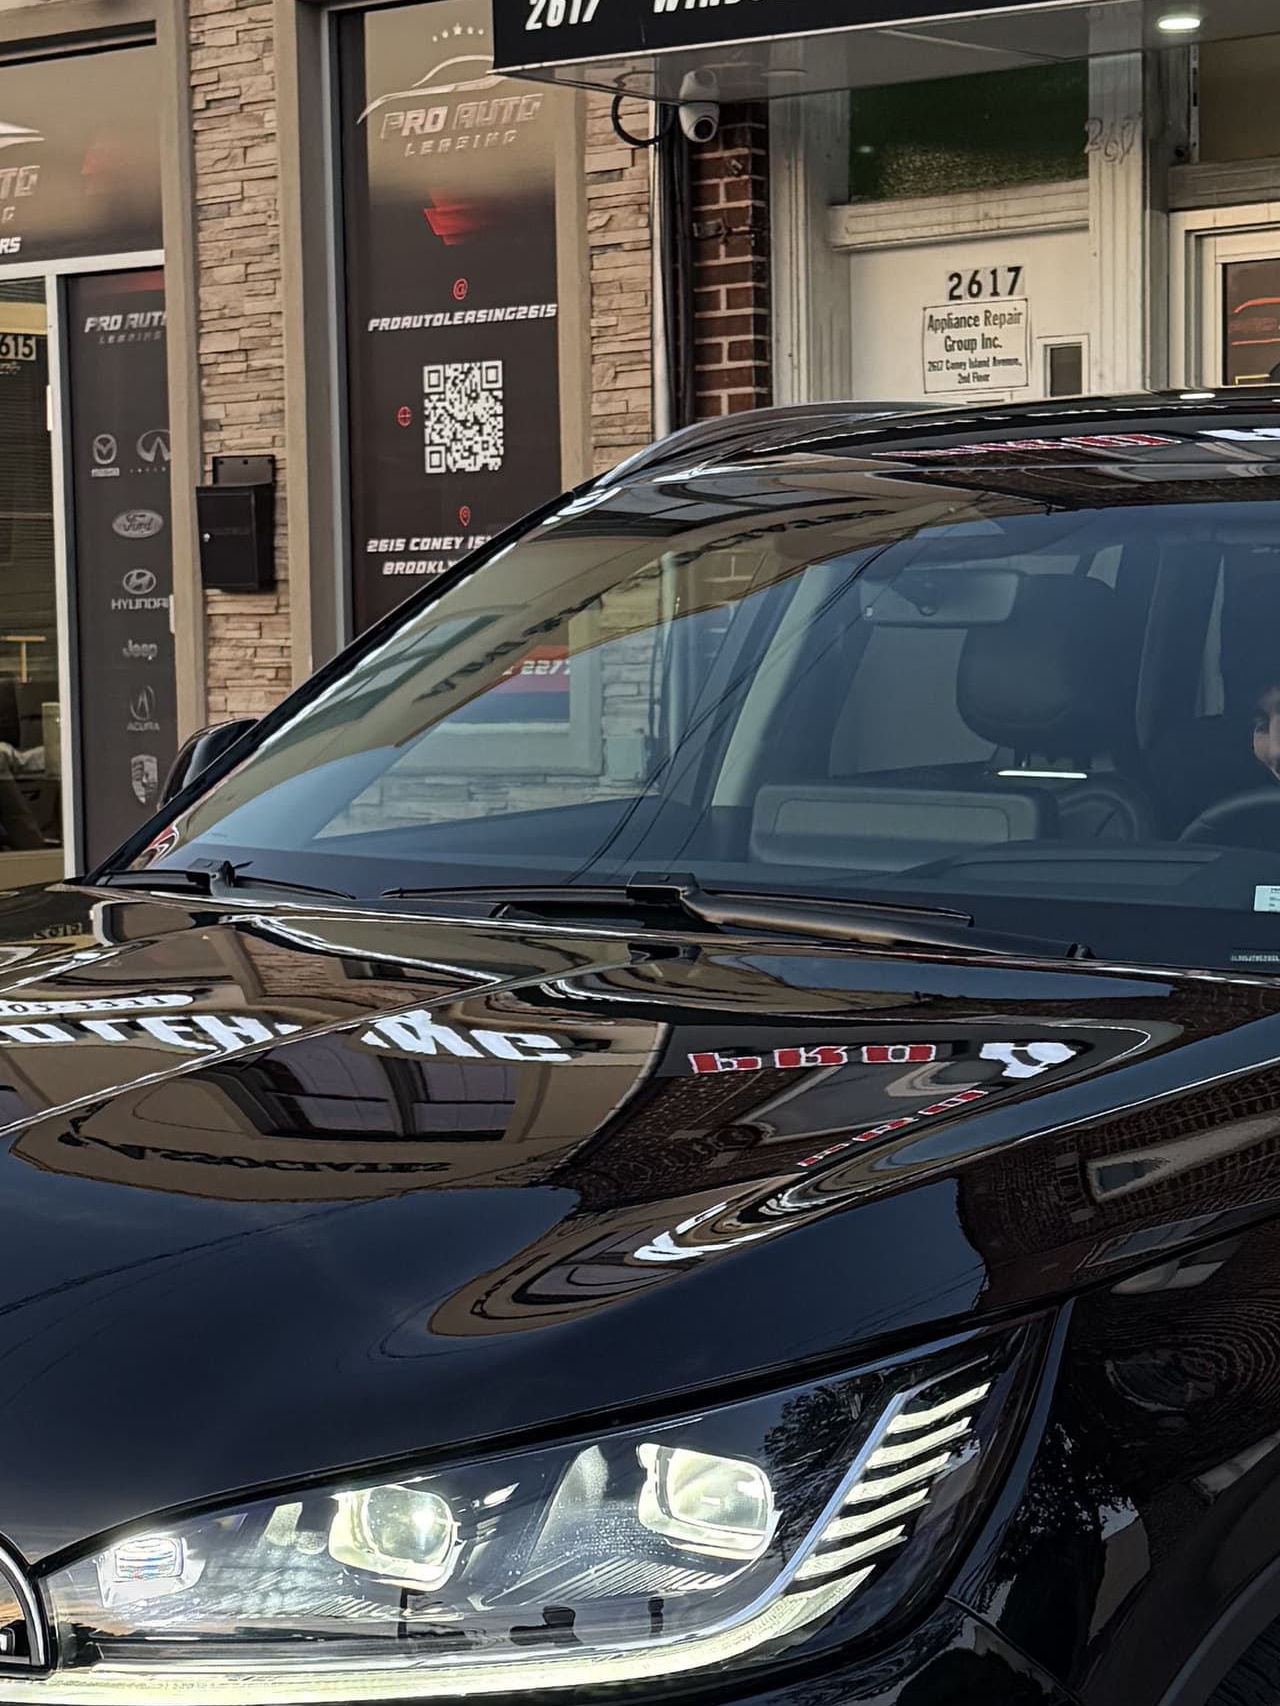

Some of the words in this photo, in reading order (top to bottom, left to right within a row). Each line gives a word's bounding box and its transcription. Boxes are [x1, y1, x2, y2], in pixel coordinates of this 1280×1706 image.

[380, 105, 449, 140] PRO
[452, 93, 544, 131] AUTO
[404, 130, 518, 159] LEASING
[948, 265, 1024, 301] 2617
[84, 313, 123, 333] PRO
[124, 310, 167, 331] AUT
[367, 303, 559, 332] PROAUTOLEASING2615
[927, 312, 980, 334] Appliance
[983, 307, 1024, 329] Repair
[944, 334, 978, 354] Group
[981, 333, 1003, 350] Inc.
[968, 357, 990, 368] Island
[366, 537, 407, 553] 2615
[408, 536, 465, 552] CONEY
[467, 535, 492, 550] IS
